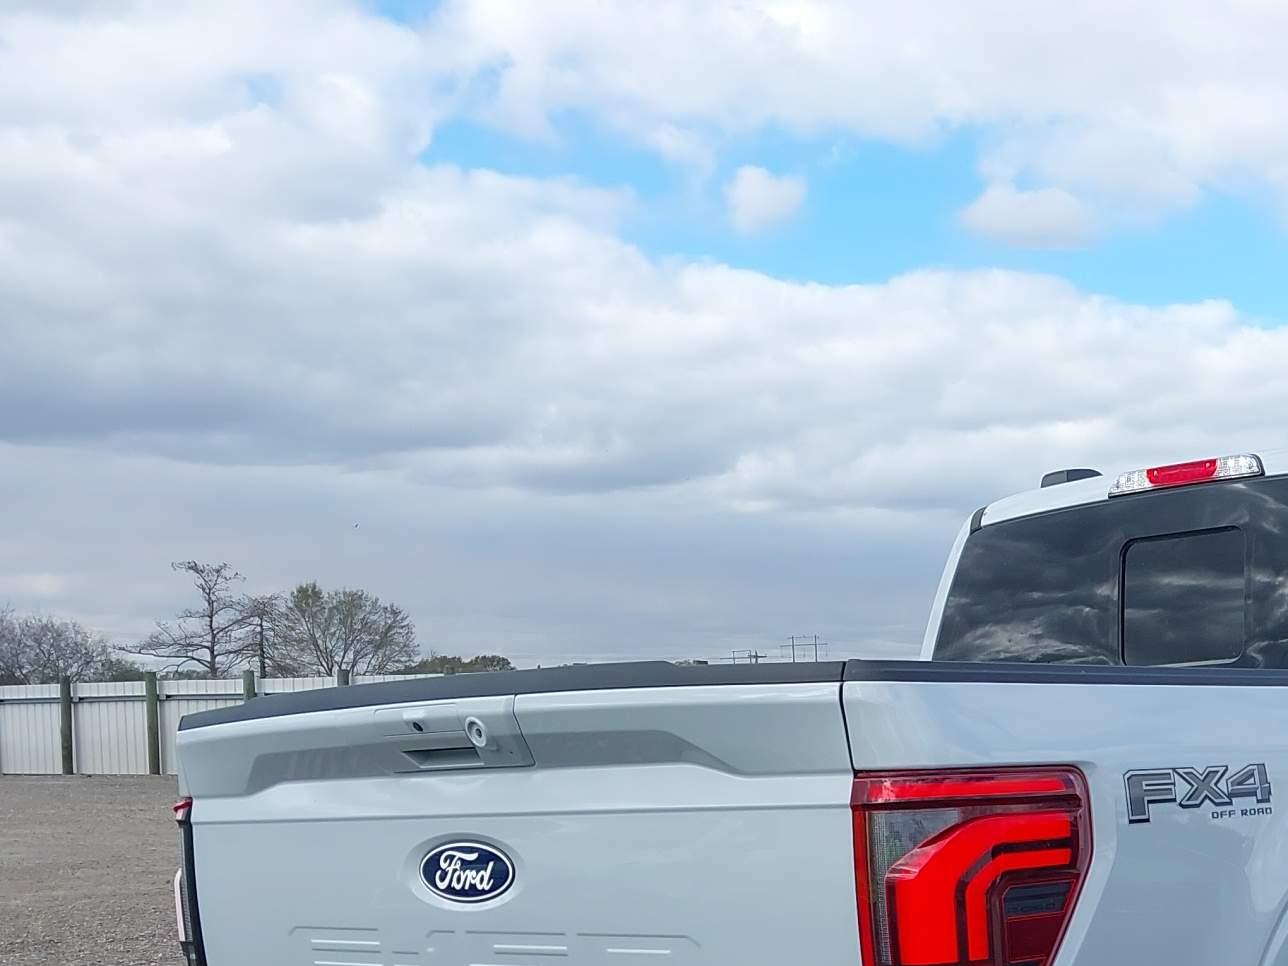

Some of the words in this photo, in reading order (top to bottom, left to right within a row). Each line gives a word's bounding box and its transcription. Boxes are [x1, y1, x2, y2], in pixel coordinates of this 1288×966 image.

[1123, 763, 1272, 824] FX4
[1211, 810, 1237, 820] OFF
[1240, 806, 1273, 818] ROAD
[434, 850, 495, 890] Ford
